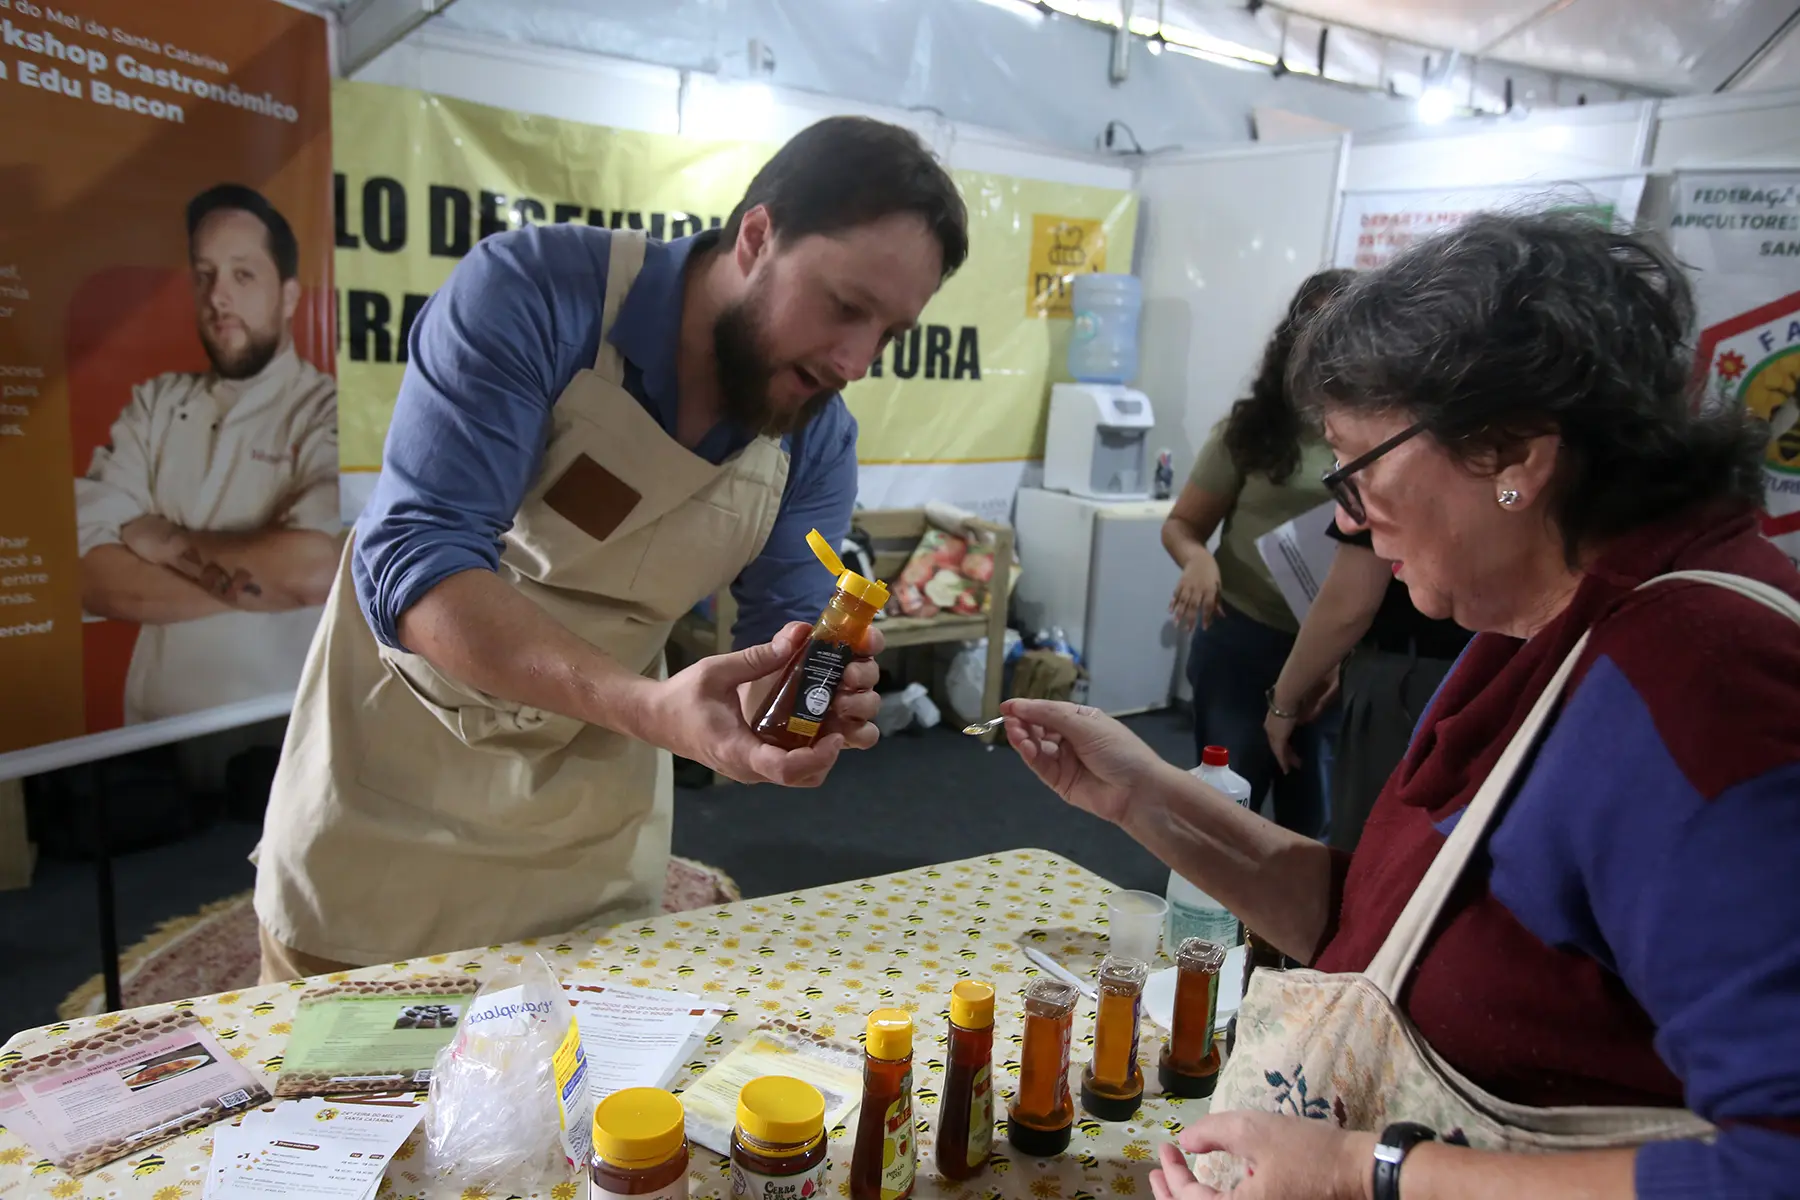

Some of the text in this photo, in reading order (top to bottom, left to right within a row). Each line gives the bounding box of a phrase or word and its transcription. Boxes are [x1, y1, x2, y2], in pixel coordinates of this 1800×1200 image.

[0, 18, 299, 123] kshop Gastronômico
[45, 6, 81, 31] Mel
[85, 20, 109, 39] de
[111, 27, 162, 54] Santa
[163, 43, 230, 75] Catarina
[17, 59, 83, 99] Edu
[90, 79, 185, 124] Bacon
[336, 289, 429, 363] RA
